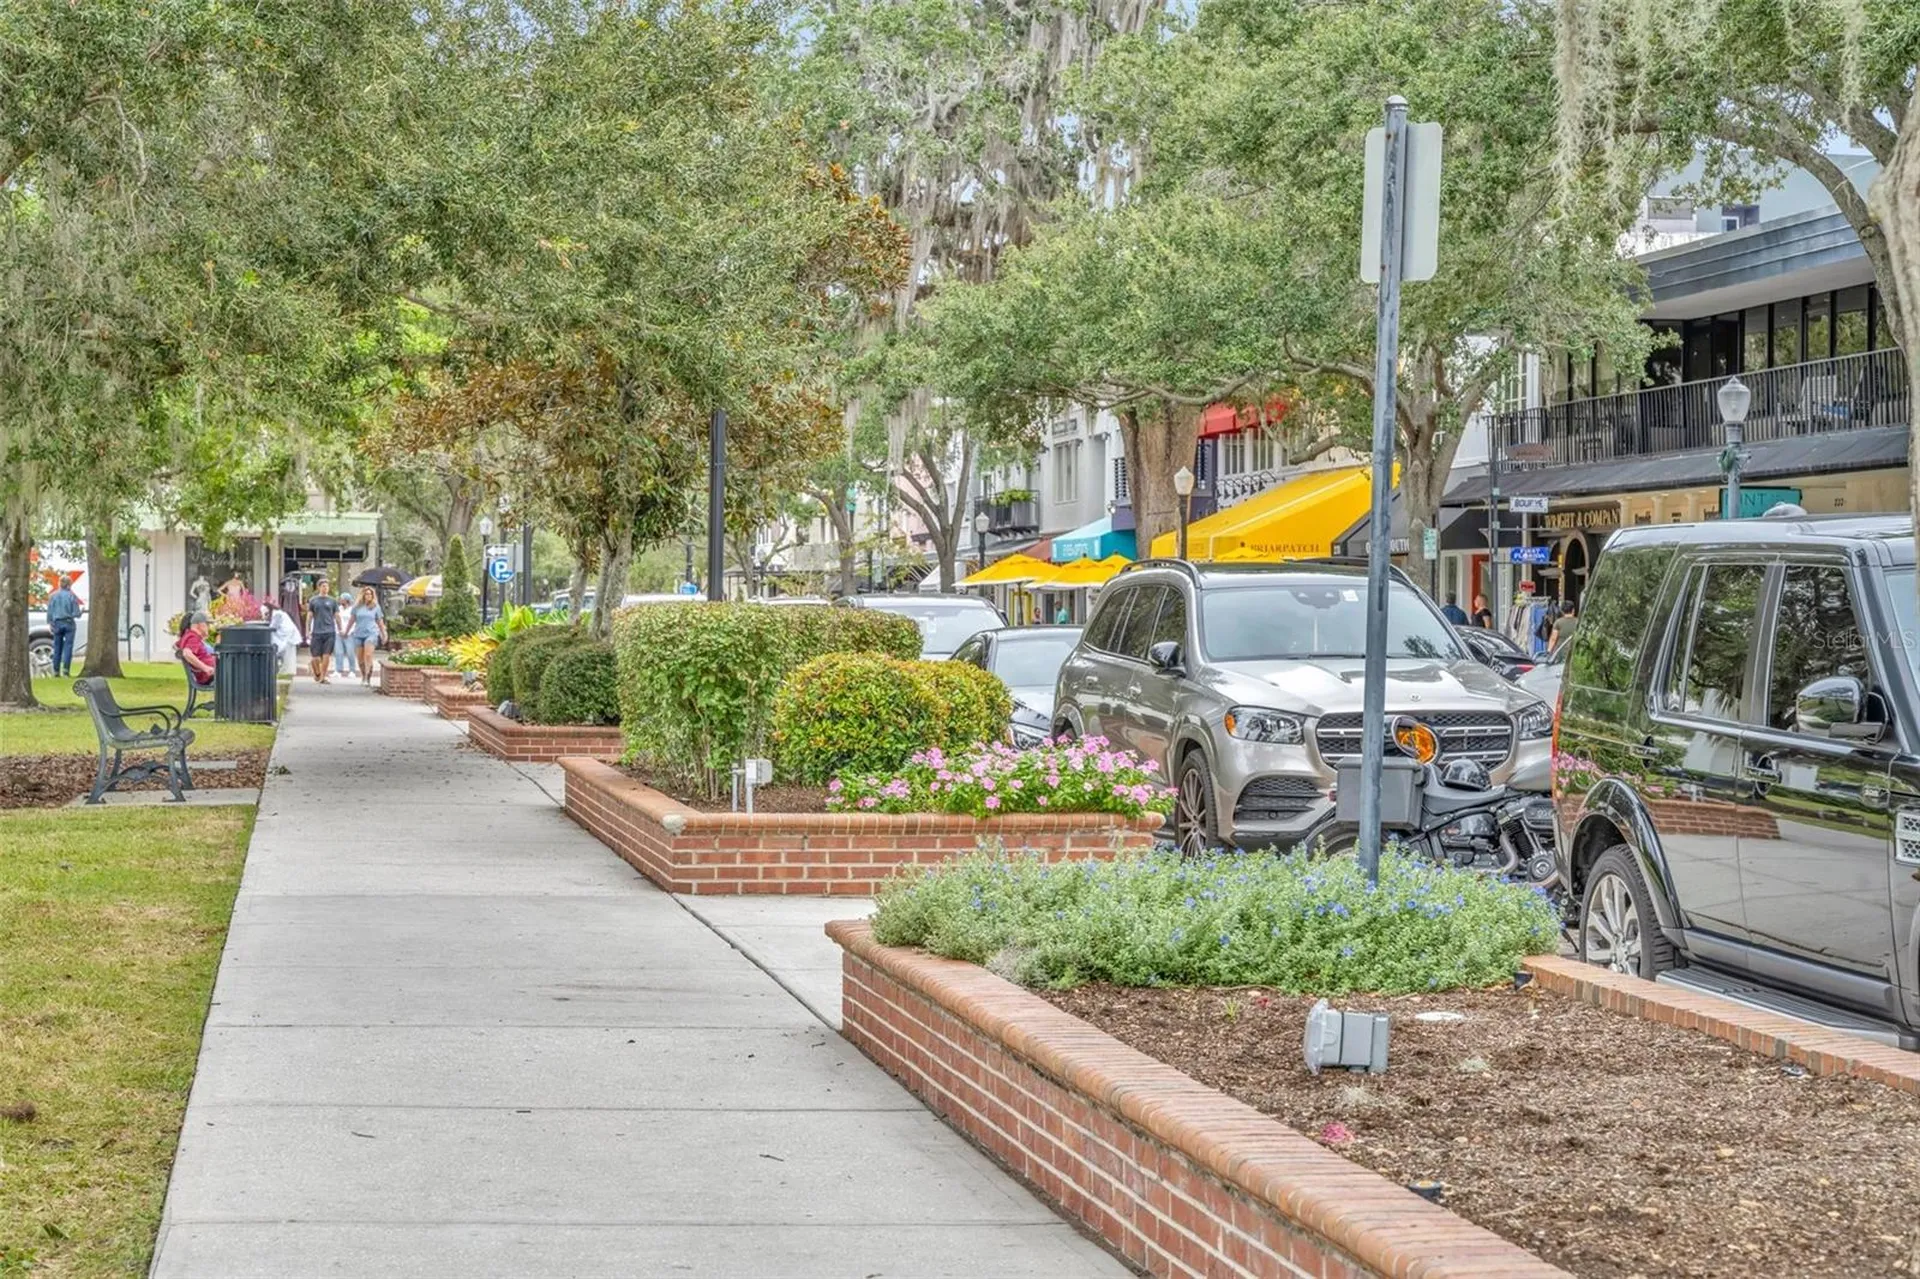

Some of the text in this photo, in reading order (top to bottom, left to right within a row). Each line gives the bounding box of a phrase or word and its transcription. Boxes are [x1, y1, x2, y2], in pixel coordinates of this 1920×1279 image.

[1725, 493, 1767, 506] INT
[1545, 512, 1575, 529] WRIGHT
[1577, 511, 1583, 527] &
[1584, 508, 1621, 528] COMPAN
[495, 561, 508, 579] P
